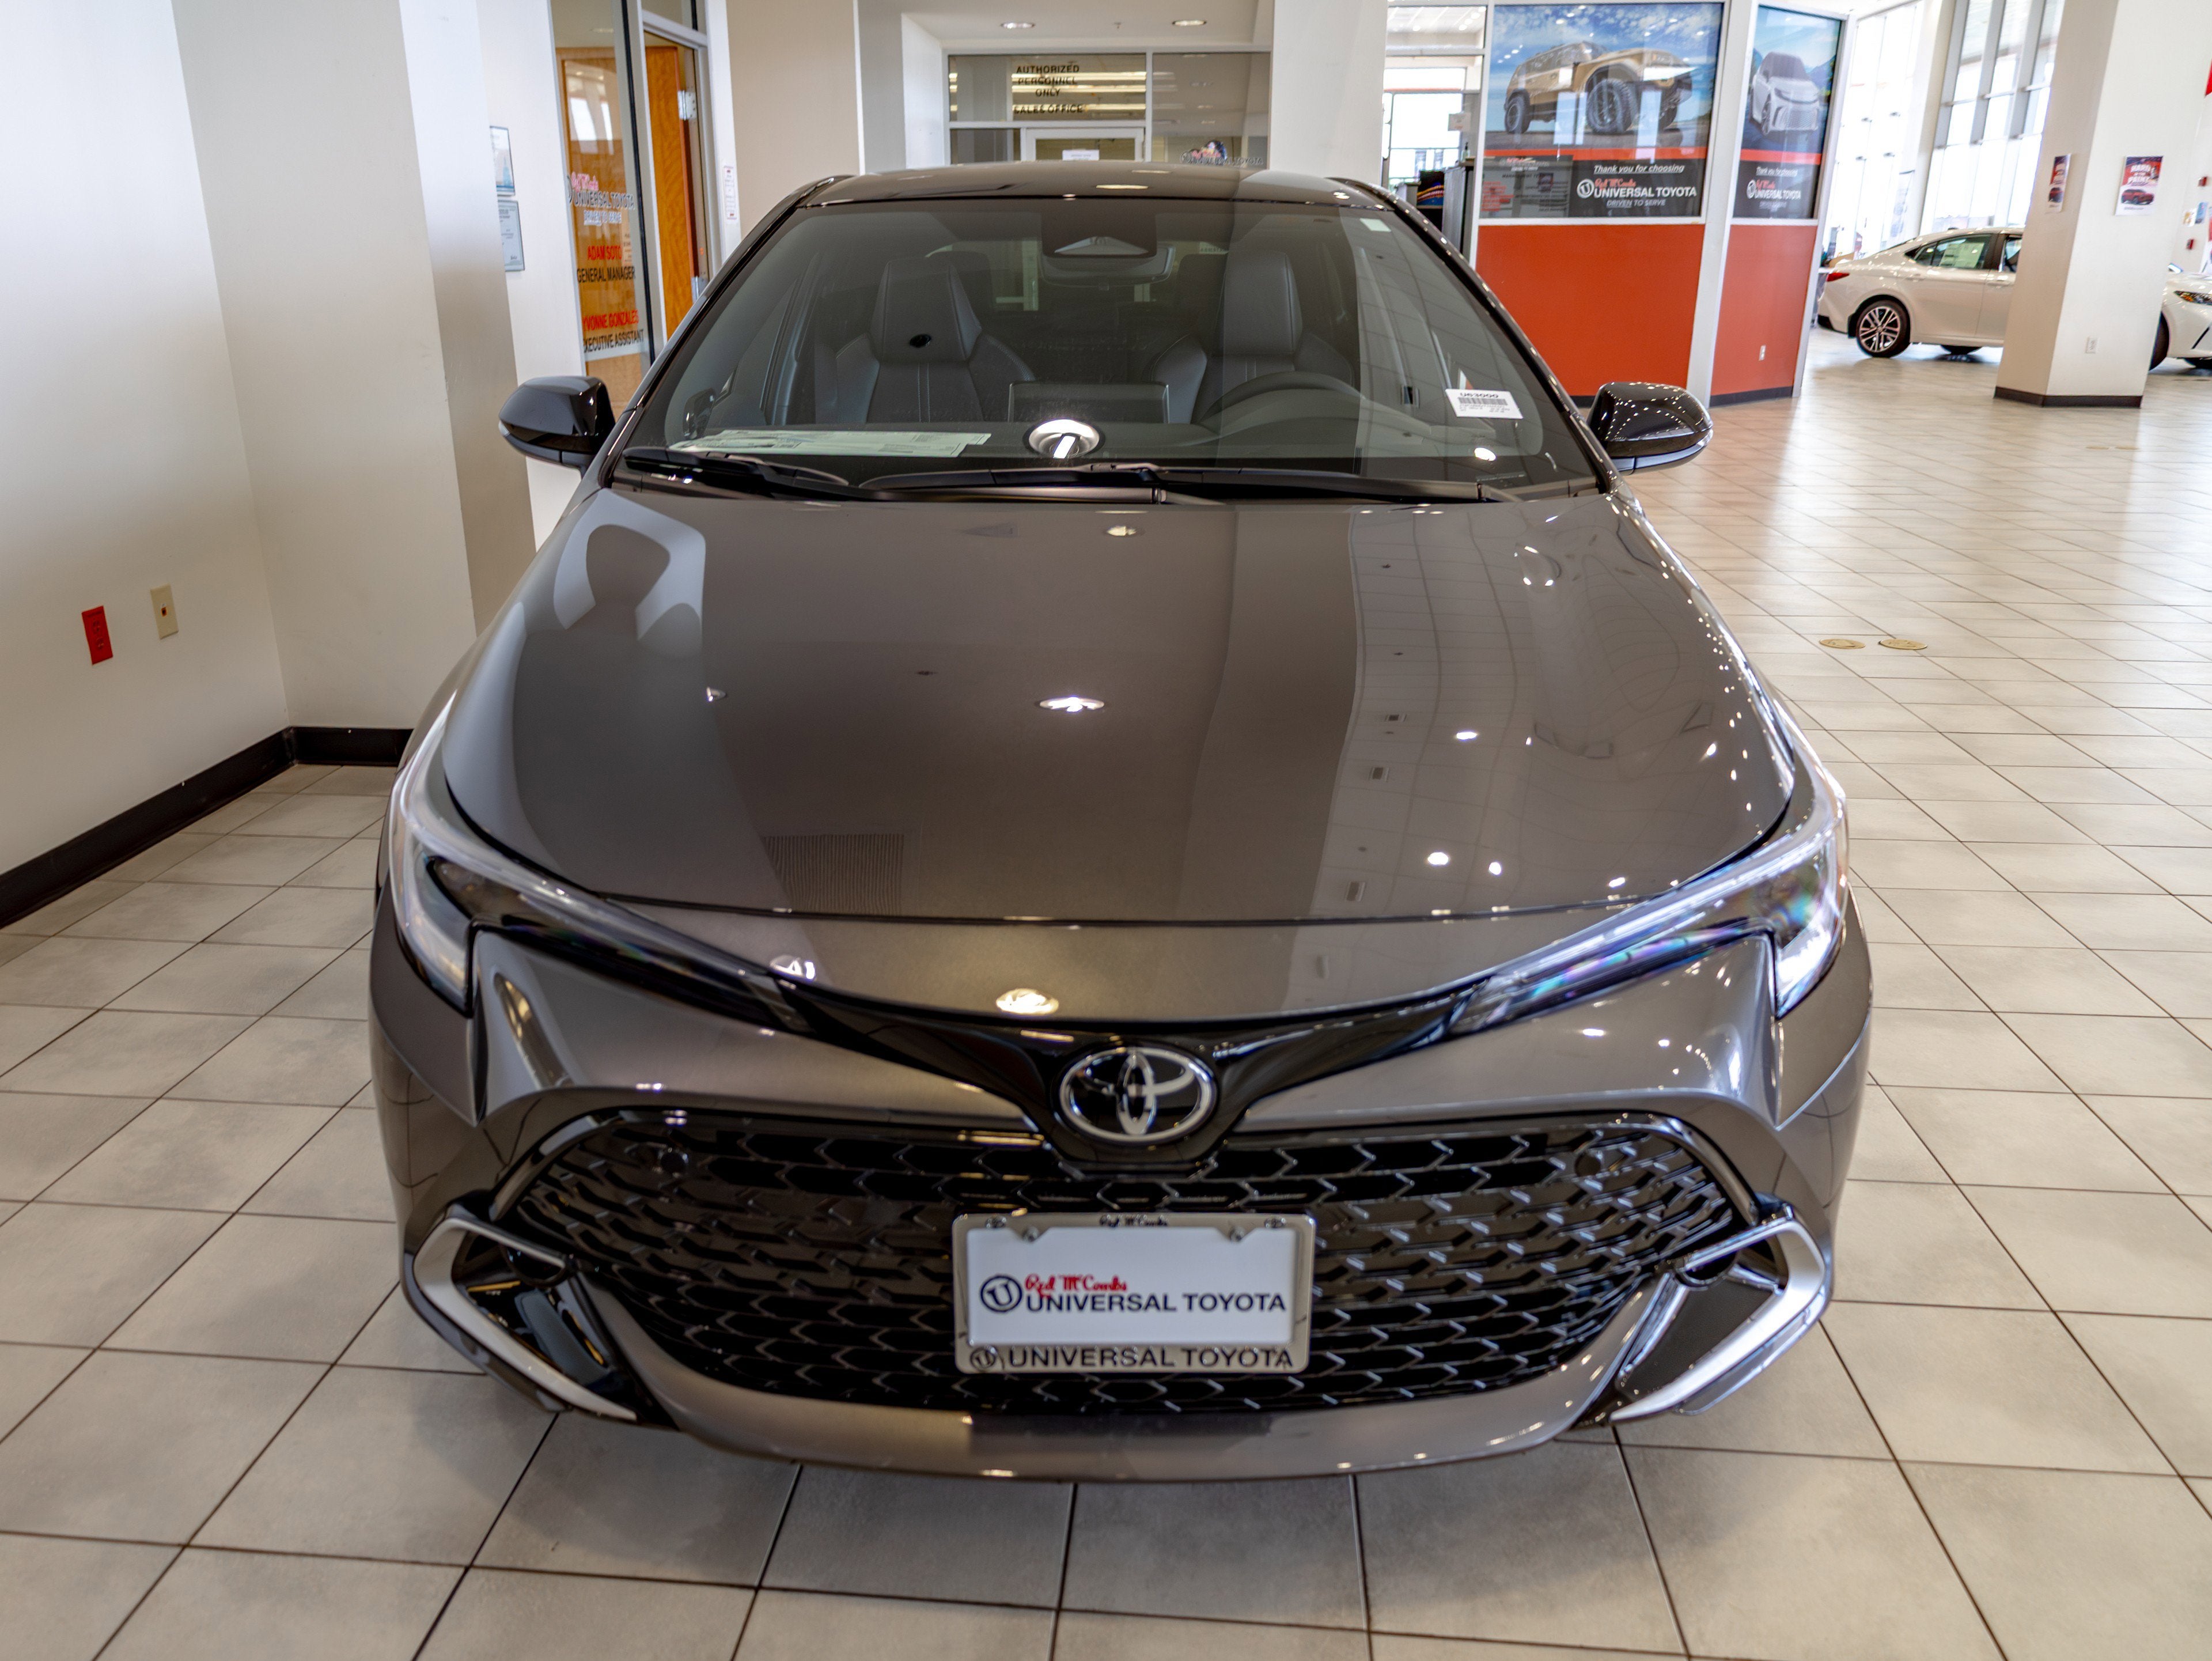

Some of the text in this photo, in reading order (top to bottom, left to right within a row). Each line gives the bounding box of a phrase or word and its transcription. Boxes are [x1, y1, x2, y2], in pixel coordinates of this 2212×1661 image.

[1016, 65, 1080, 73] AUTHORIZED
[1017, 77, 1078, 85] PERSONNEL
[1035, 88, 1060, 97] ONLY
[1013, 104, 1084, 114] SALES OFFICE
[1593, 164, 1685, 175] Thank you for choosing
[1594, 186, 1654, 198] UNIVERSAL
[1656, 186, 1698, 198] TOYOTA
[1755, 188, 1801, 200] UNIVERSAL TOYOTA
[573, 190, 635, 210] UNIVERSAL TOYOTA
[1606, 199, 1633, 209] DRIVEN
[1645, 199, 1666, 207] SERVE
[588, 245, 605, 260] ADAM
[606, 244, 622, 260] SOTO
[577, 266, 636, 283] GENERAL MANAGER
[582, 309, 639, 332] YVONNE GONZALES
[615, 329, 644, 347] ASSISTANT
[1025, 1273, 1056, 1299] Red
[1027, 1293, 1176, 1312] UNIVERSAL
[1183, 1293, 1286, 1312] TOYOTA
[1009, 1347, 1175, 1368] UNIVERSAL
[1181, 1347, 1293, 1368] TOYOTA
